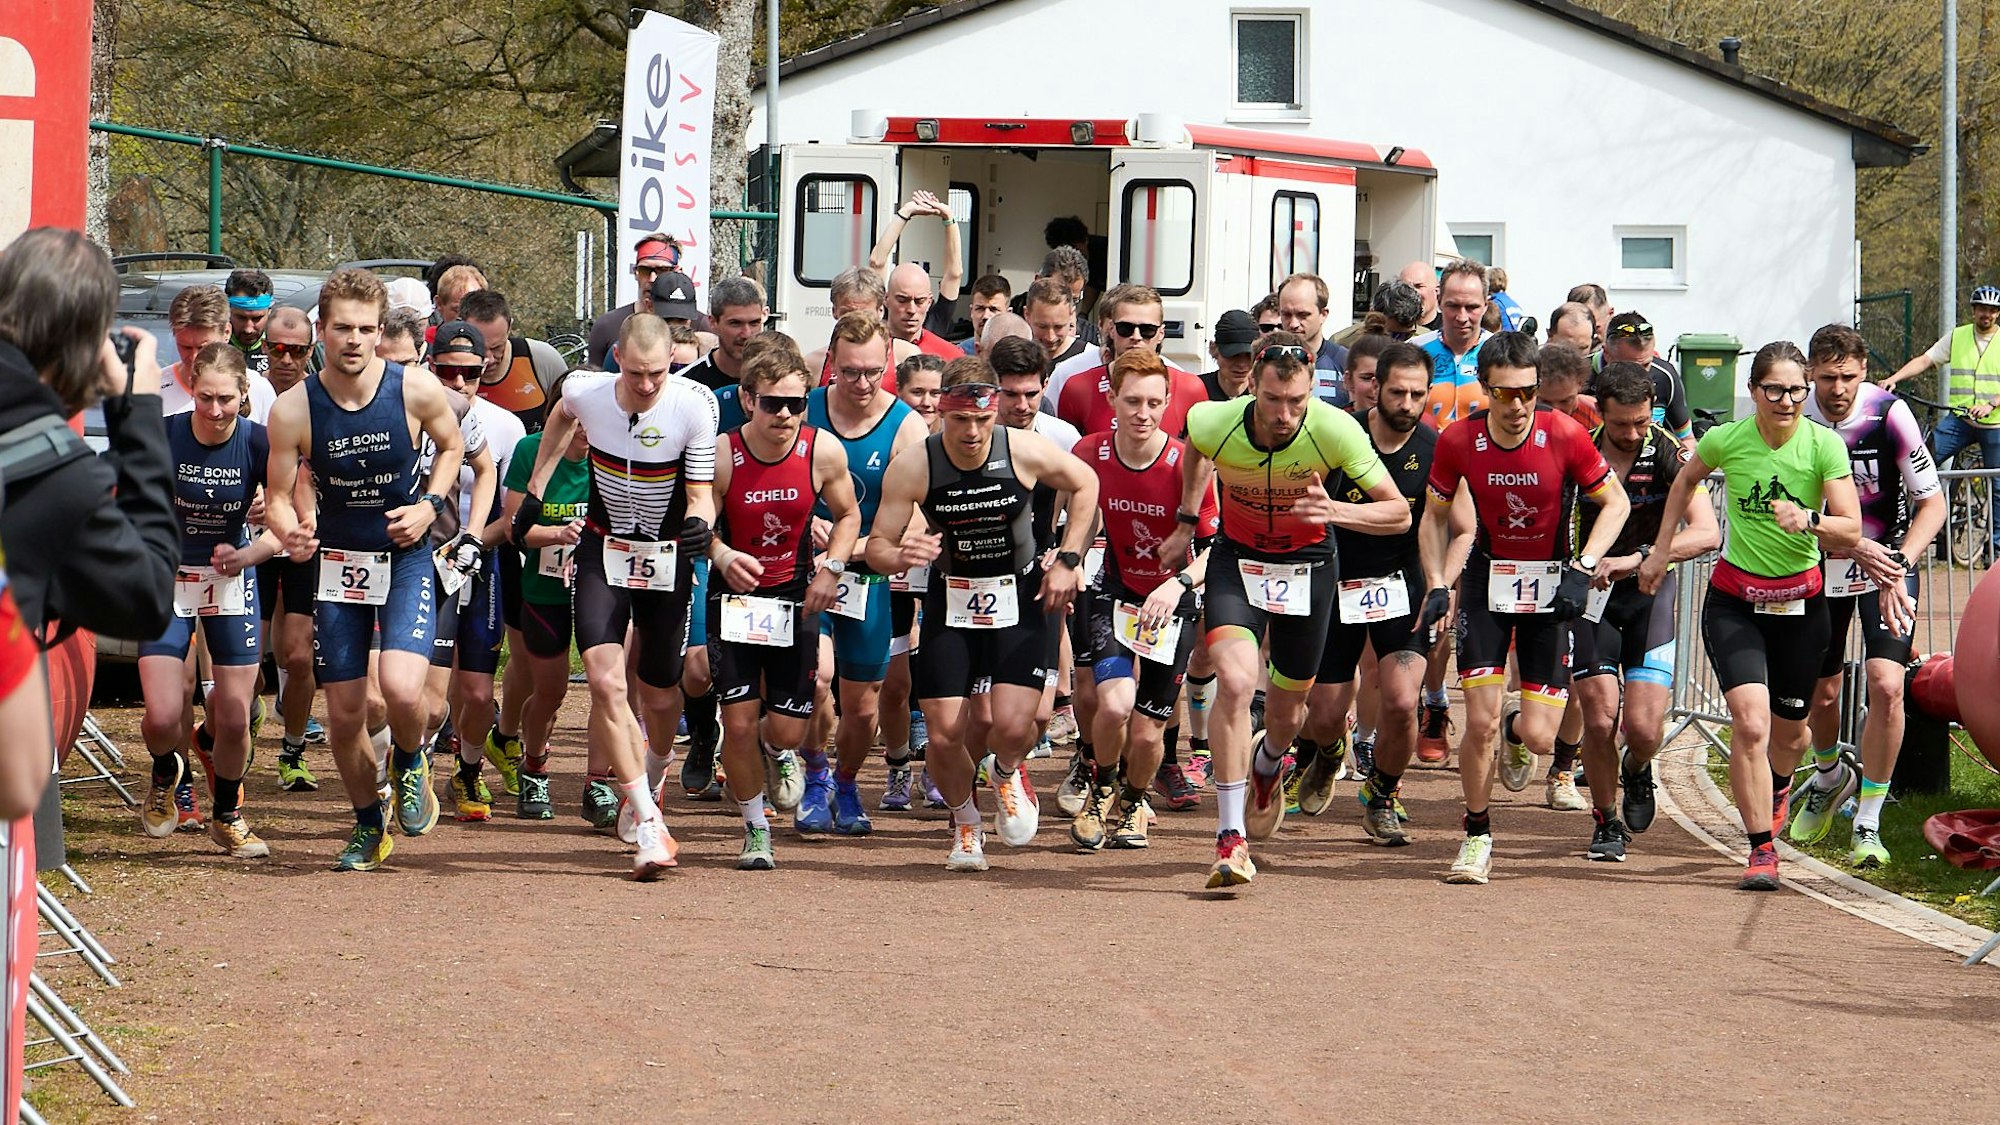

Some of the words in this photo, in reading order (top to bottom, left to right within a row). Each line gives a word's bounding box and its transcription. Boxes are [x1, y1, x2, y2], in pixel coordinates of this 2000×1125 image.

[629, 53, 671, 232] bike
[328, 438, 349, 452] SSF
[352, 431, 390, 447] BONN
[329, 446, 368, 459] TRIATHLON
[370, 443, 391, 452] TEAM
[178, 473, 219, 486] TRIATHLON
[179, 463, 201, 475] SSF
[204, 467, 241, 478] BONN
[1487, 472, 1539, 486] FROHN
[744, 488, 798, 504] SCHELD
[935, 494, 1019, 513] MORGENWECK
[1108, 498, 1166, 517] HOLDER
[973, 537, 1006, 546] WIRTH
[341, 566, 371, 590] 52
[625, 556, 656, 578] 15
[203, 584, 215, 605] 1
[1260, 578, 1290, 602] 12
[1360, 586, 1389, 609] 40
[1512, 578, 1540, 601] 11
[243, 578, 256, 648] RYZON
[412, 576, 431, 640] RYZON
[967, 592, 998, 615] 42
[744, 611, 775, 634] 14
[1133, 621, 1158, 645] 13
